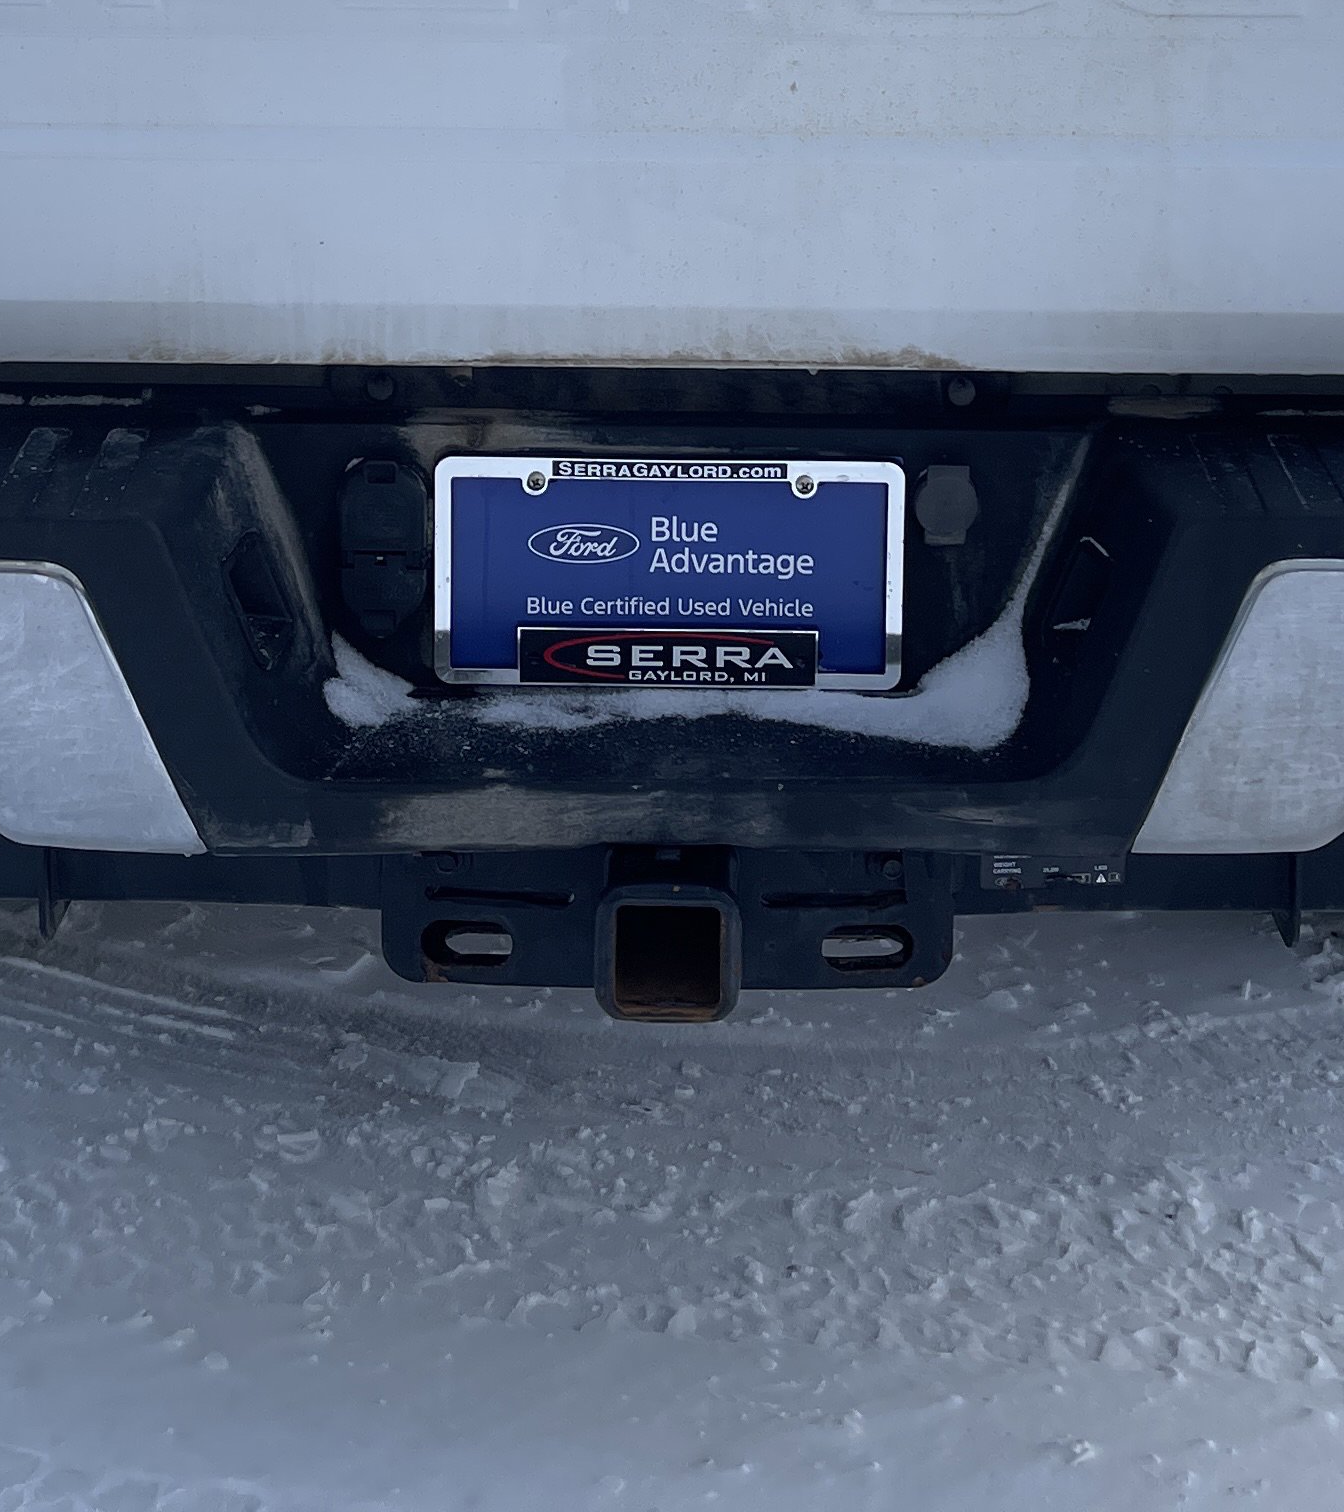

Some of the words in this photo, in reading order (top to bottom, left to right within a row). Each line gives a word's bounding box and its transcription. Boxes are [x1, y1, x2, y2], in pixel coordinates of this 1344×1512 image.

[558, 461, 783, 479] SERRAGAYLORD.com
[650, 515, 719, 543] Blue
[548, 528, 618, 557] Ford
[649, 547, 815, 580] Advantage
[526, 596, 574, 615] Blue
[580, 597, 670, 616] Certified
[677, 598, 731, 617] Used
[738, 598, 814, 617] Vehicle
[586, 645, 794, 669] SERRA
[628, 670, 735, 684] GAYLORD,
[744, 672, 767, 682] MI
